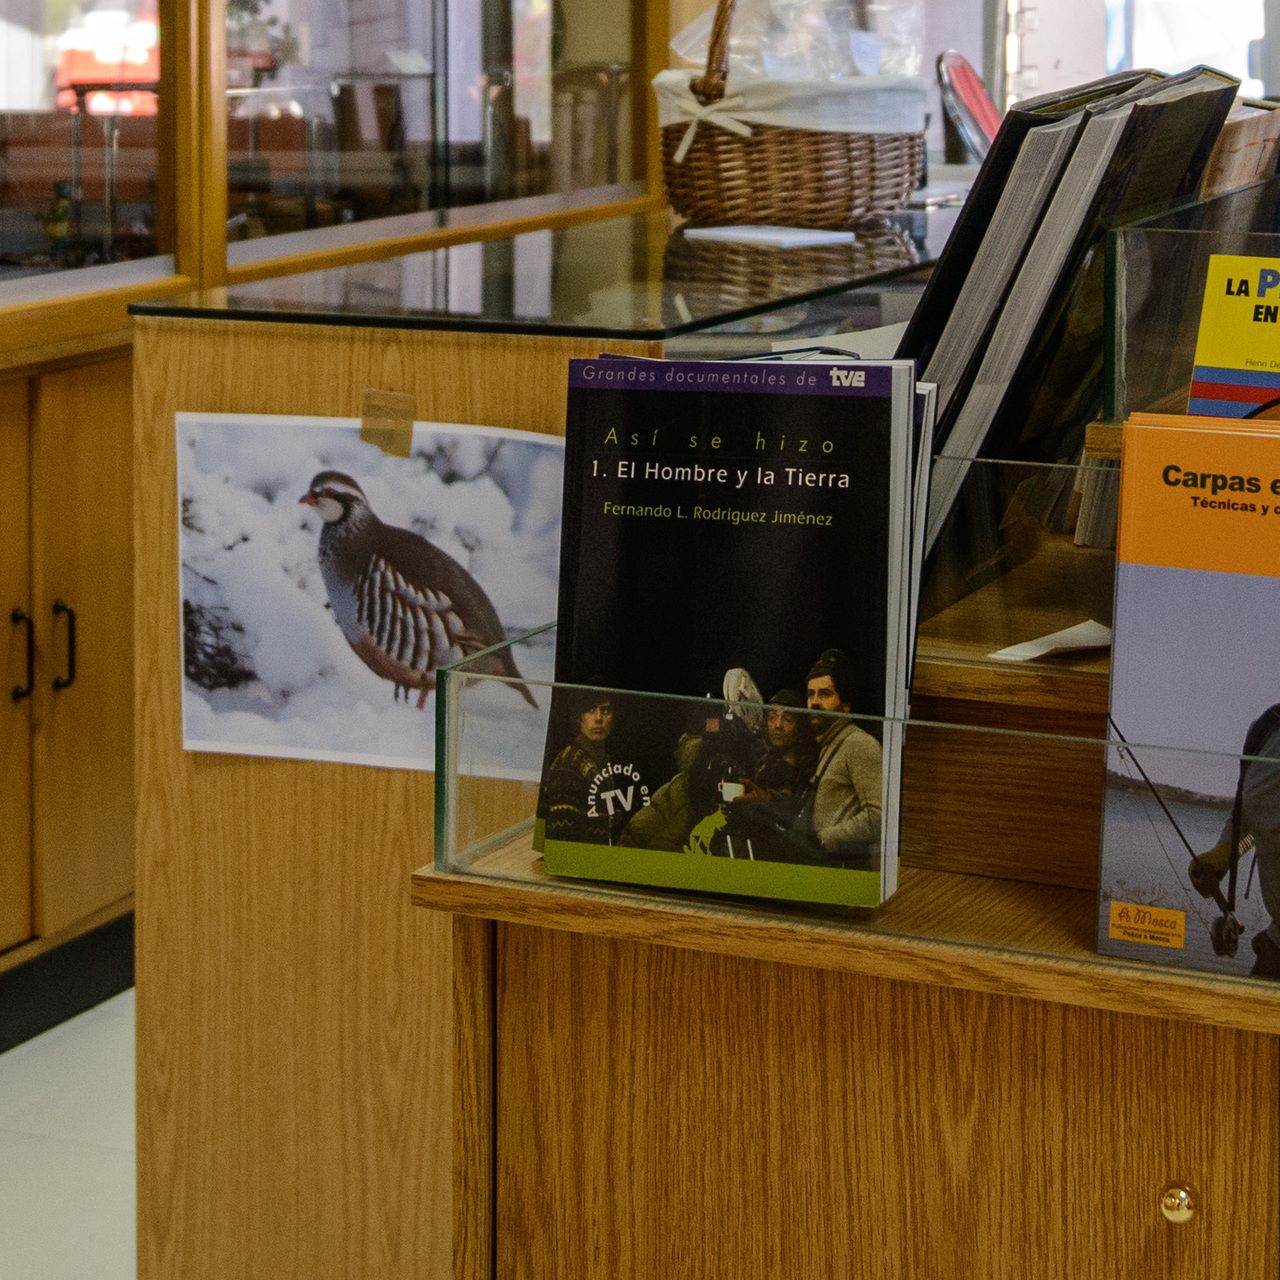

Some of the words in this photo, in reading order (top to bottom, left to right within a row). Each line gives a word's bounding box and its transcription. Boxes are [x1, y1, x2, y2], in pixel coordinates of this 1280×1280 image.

[1225, 278, 1250, 297] LA
[1253, 304, 1279, 324] EN
[1245, 358, 1267, 369] Henri
[582, 365, 656, 383] Grandes
[665, 368, 786, 386] documentales
[796, 370, 817, 386] de
[604, 427, 659, 447] Así
[689, 435, 721, 449] se
[755, 431, 834, 453] hizo
[592, 460, 608, 478] 1.
[617, 461, 635, 479] El
[645, 462, 727, 483] Hombre
[736, 470, 748, 489] y
[757, 467, 774, 485] la
[785, 468, 849, 488] Tierra
[1162, 464, 1261, 495] Carpas
[603, 501, 671, 518] Fernando
[677, 505, 688, 519] L.
[771, 509, 832, 526] Jiménez
[1191, 496, 1257, 512] Técnicas
[1261, 504, 1269, 516] y
[587, 762, 640, 817] Anunciado
[640, 785, 651, 807] en
[600, 785, 634, 815] TV
[1133, 909, 1177, 930] Mosca
